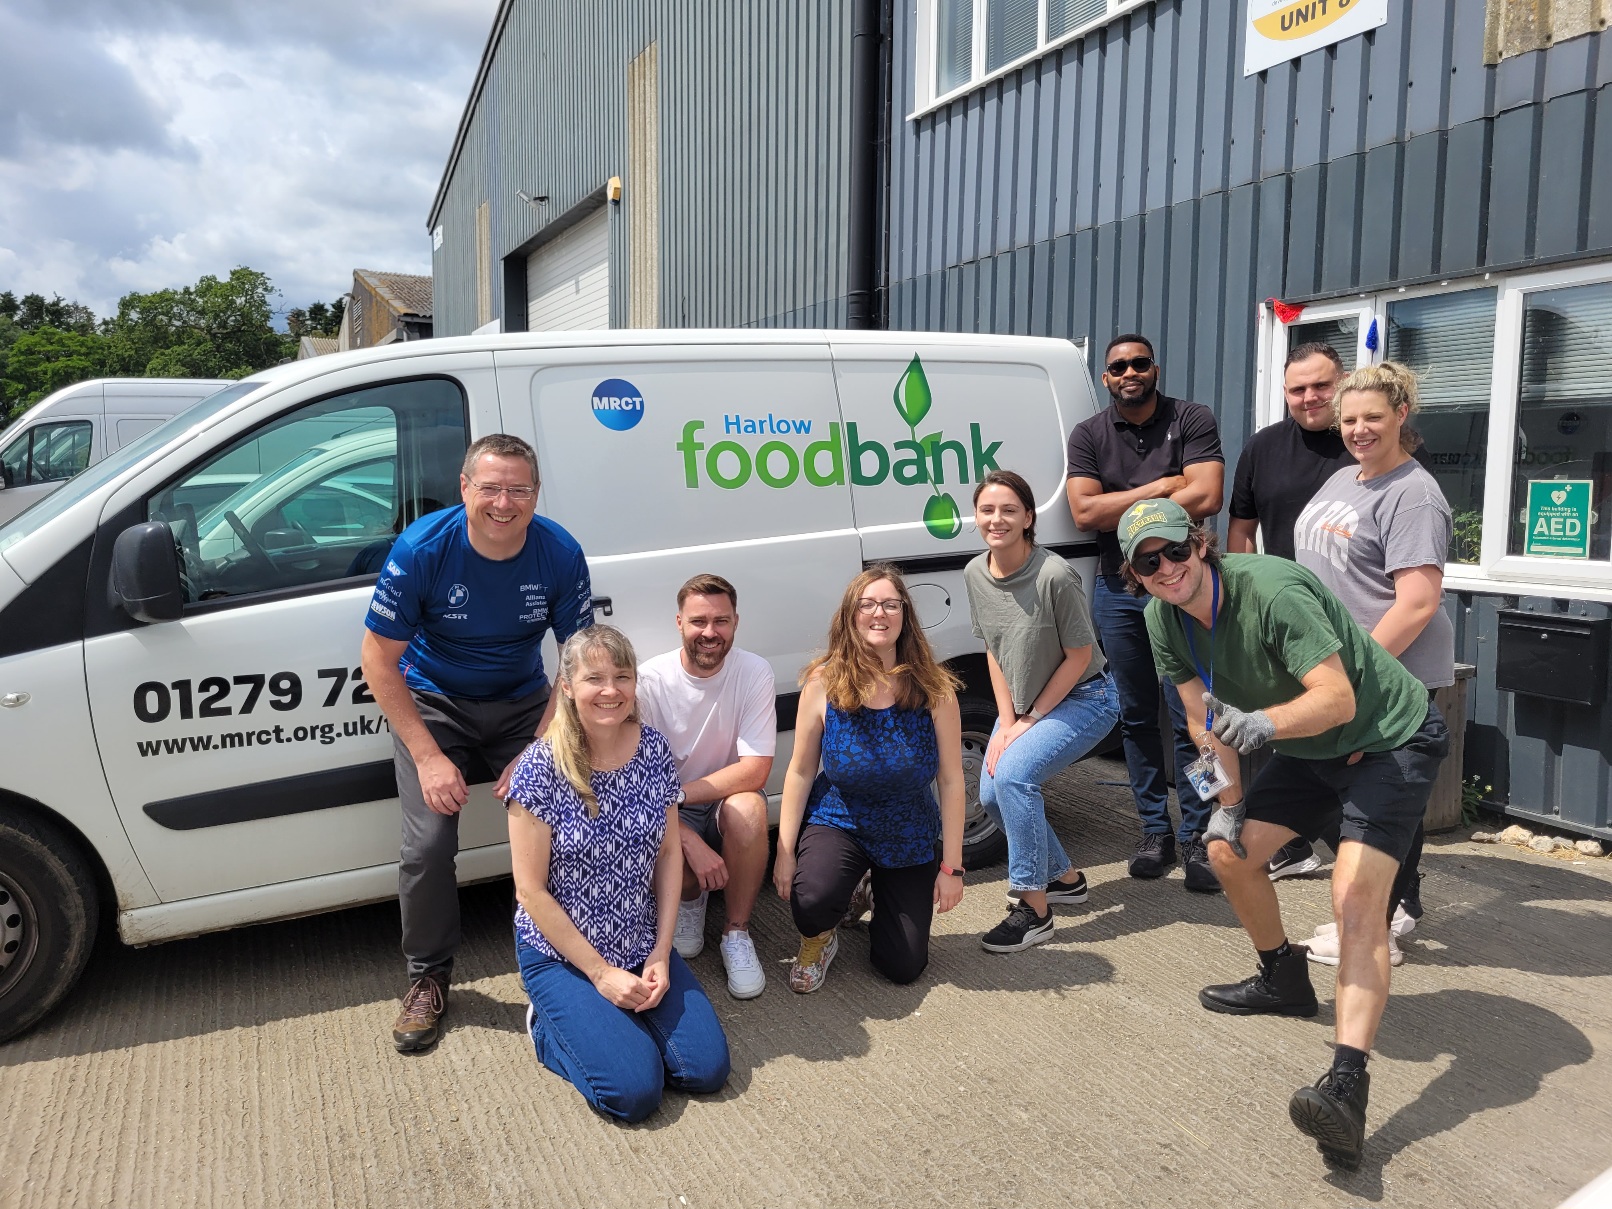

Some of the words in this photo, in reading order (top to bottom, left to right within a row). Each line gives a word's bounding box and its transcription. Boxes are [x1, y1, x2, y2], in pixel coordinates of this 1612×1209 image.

[1281, 0, 1328, 32] UNIT
[592, 396, 644, 411] MRCT
[723, 412, 812, 435] Harlow
[675, 419, 1004, 490] foodbank
[1533, 517, 1581, 536] AED
[387, 561, 401, 576] SAP
[133, 671, 303, 723] 01279
